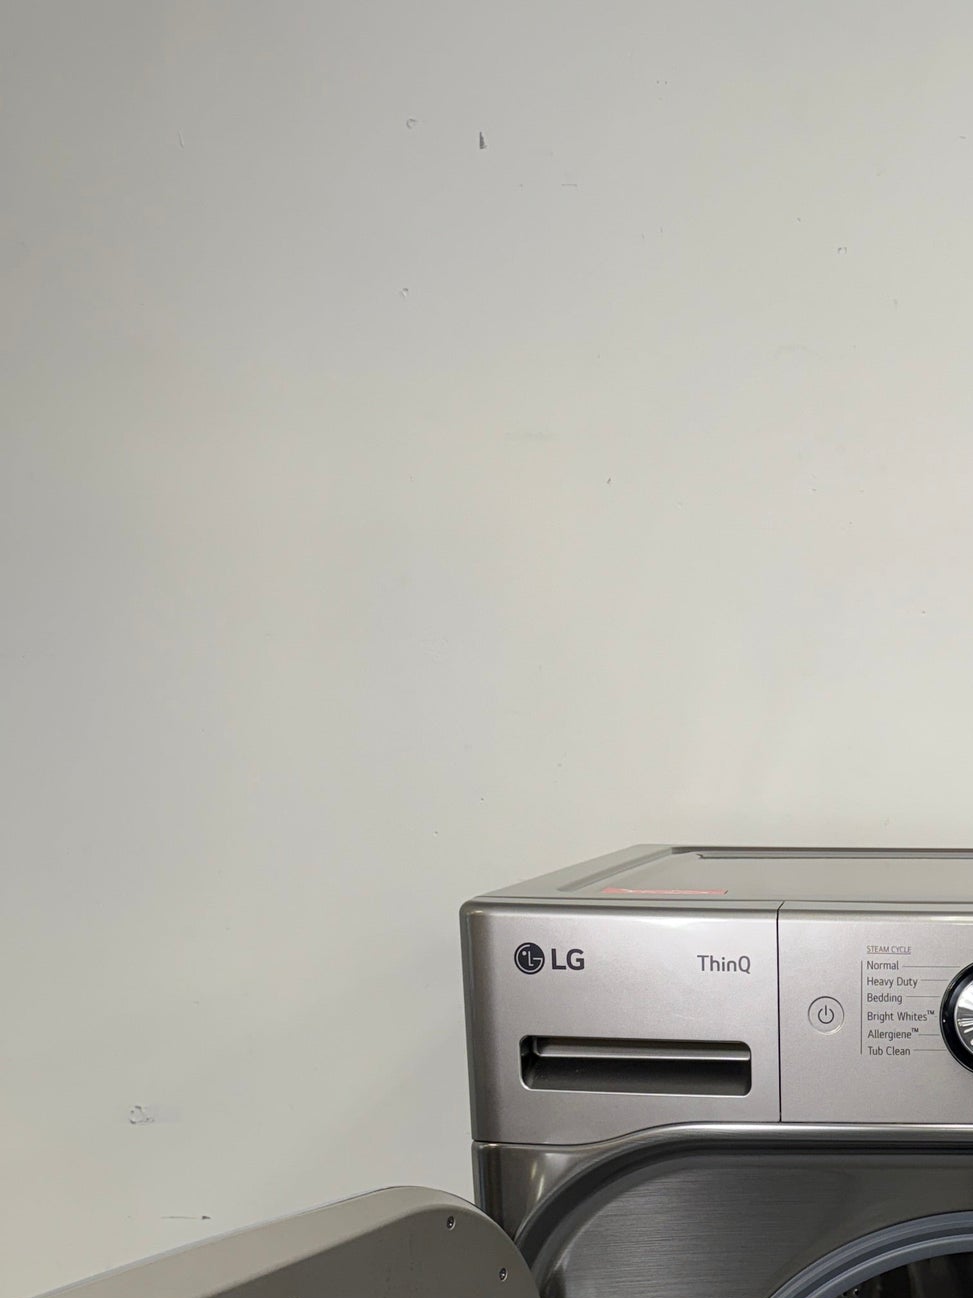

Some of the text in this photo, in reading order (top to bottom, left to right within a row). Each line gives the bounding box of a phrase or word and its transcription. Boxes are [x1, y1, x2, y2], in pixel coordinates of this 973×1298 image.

[866, 945, 912, 953] STEAM CYCLE
[551, 948, 585, 971] LG
[697, 954, 751, 974] ThinQ
[866, 960, 899, 970] Normal
[866, 976, 918, 988] Heavy Duty
[866, 993, 903, 1005] Bedding
[867, 1011, 894, 1022] Bright
[867, 1046, 911, 1056] Tub Clean
